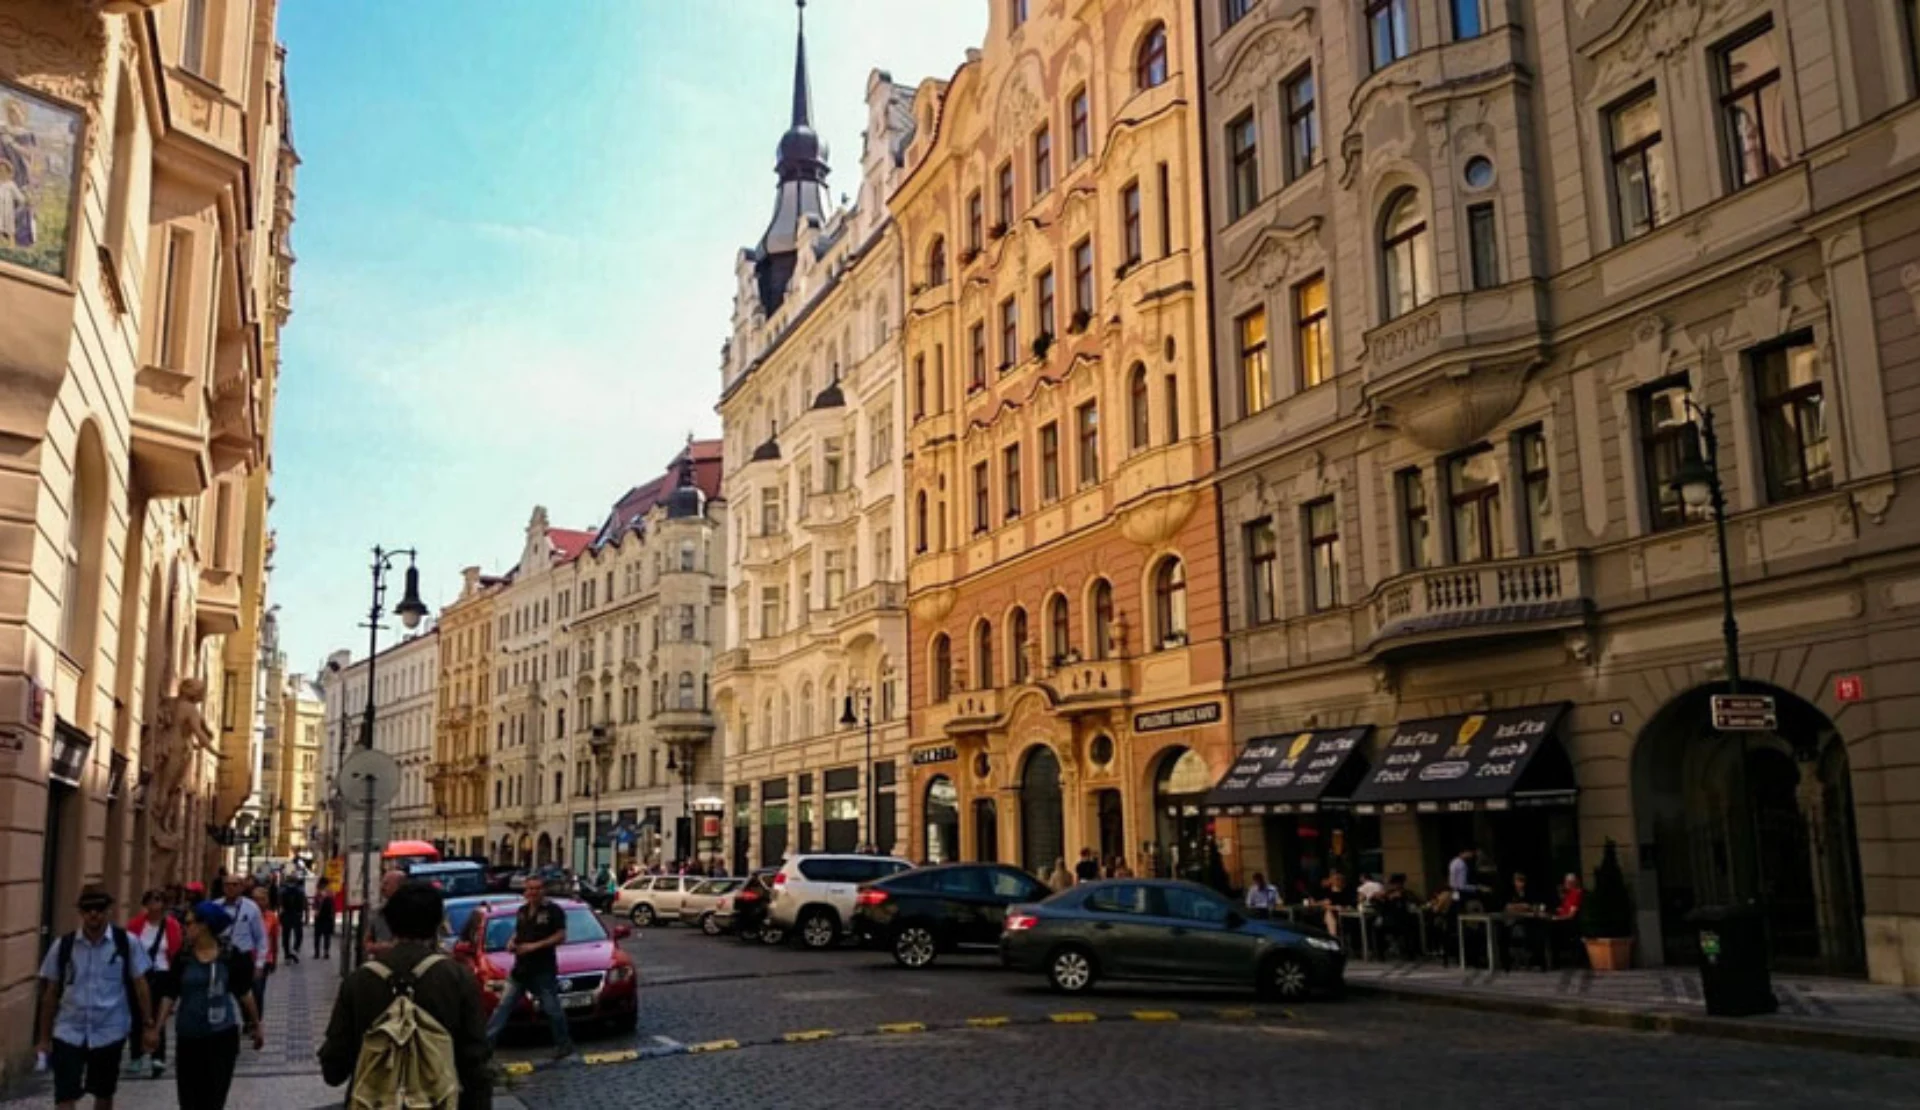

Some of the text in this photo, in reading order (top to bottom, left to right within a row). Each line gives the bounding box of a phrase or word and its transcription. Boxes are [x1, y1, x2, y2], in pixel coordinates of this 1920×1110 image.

[1496, 721, 1546, 738] kafka
[1317, 738, 1354, 752] kafka
[1394, 731, 1439, 746] kafka
[1373, 767, 1411, 783] food
[1475, 760, 1516, 777] food
